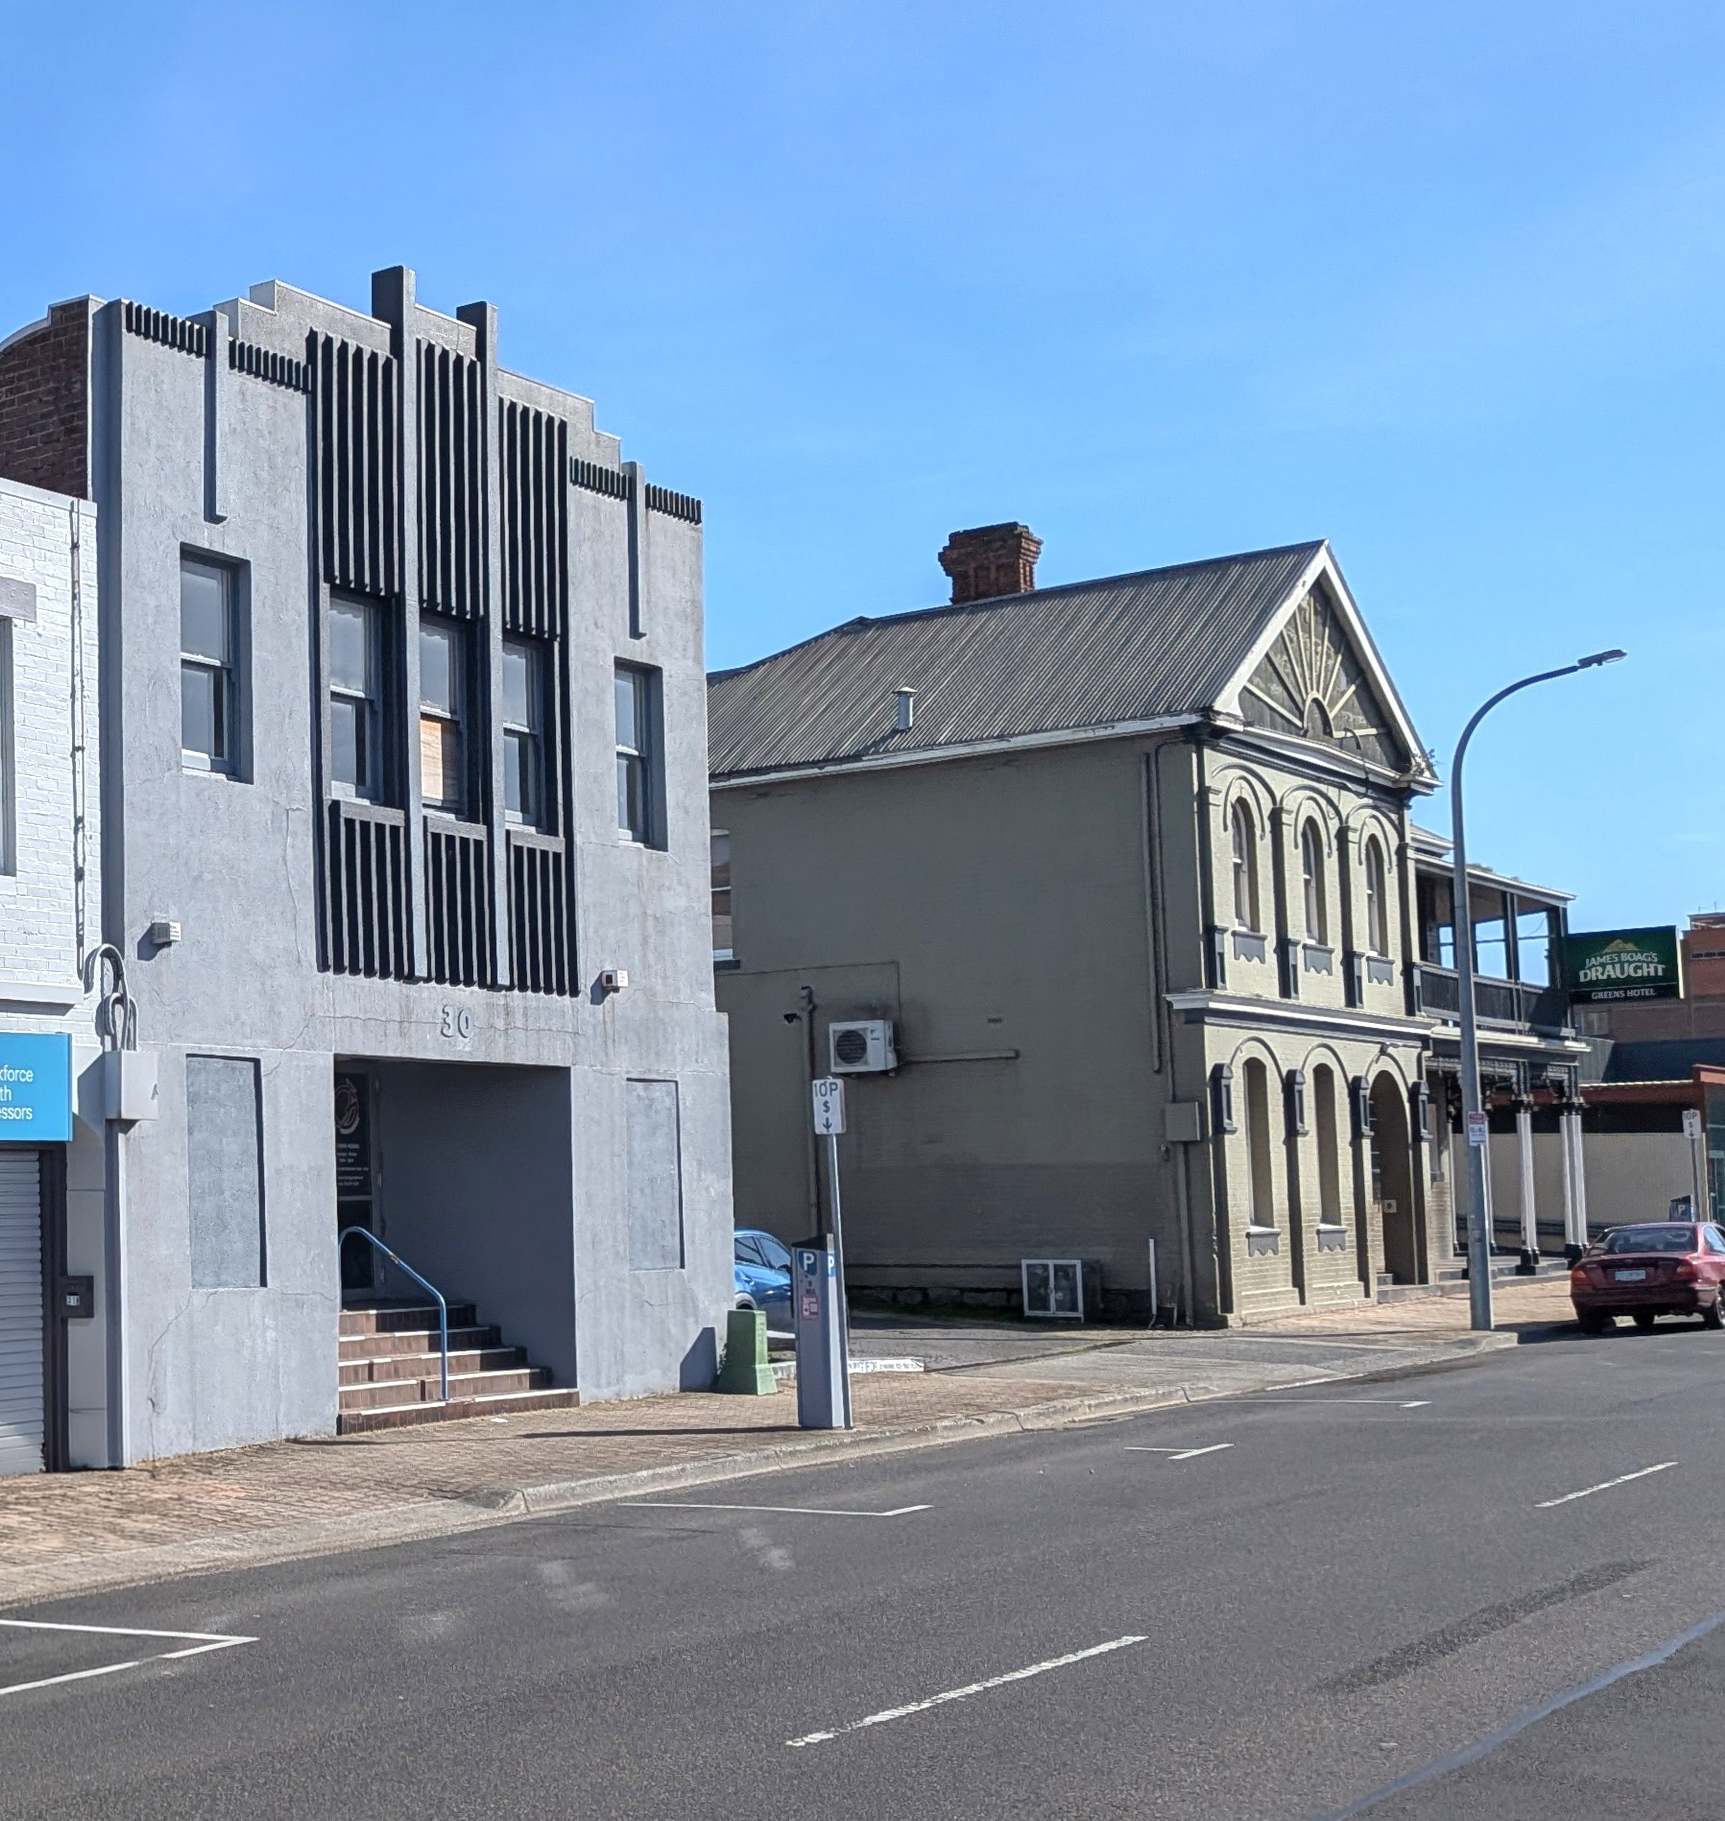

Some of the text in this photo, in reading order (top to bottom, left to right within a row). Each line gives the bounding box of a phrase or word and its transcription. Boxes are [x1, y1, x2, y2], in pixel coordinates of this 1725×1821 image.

[1585, 951, 1658, 969] JAMES BOAG'S
[1579, 962, 1666, 982] DRAUGHT
[1627, 988, 1656, 997] HOTEL
[441, 1004, 474, 1039] 30
[815, 1081, 838, 1097] 10P
[803, 1252, 815, 1271] P
